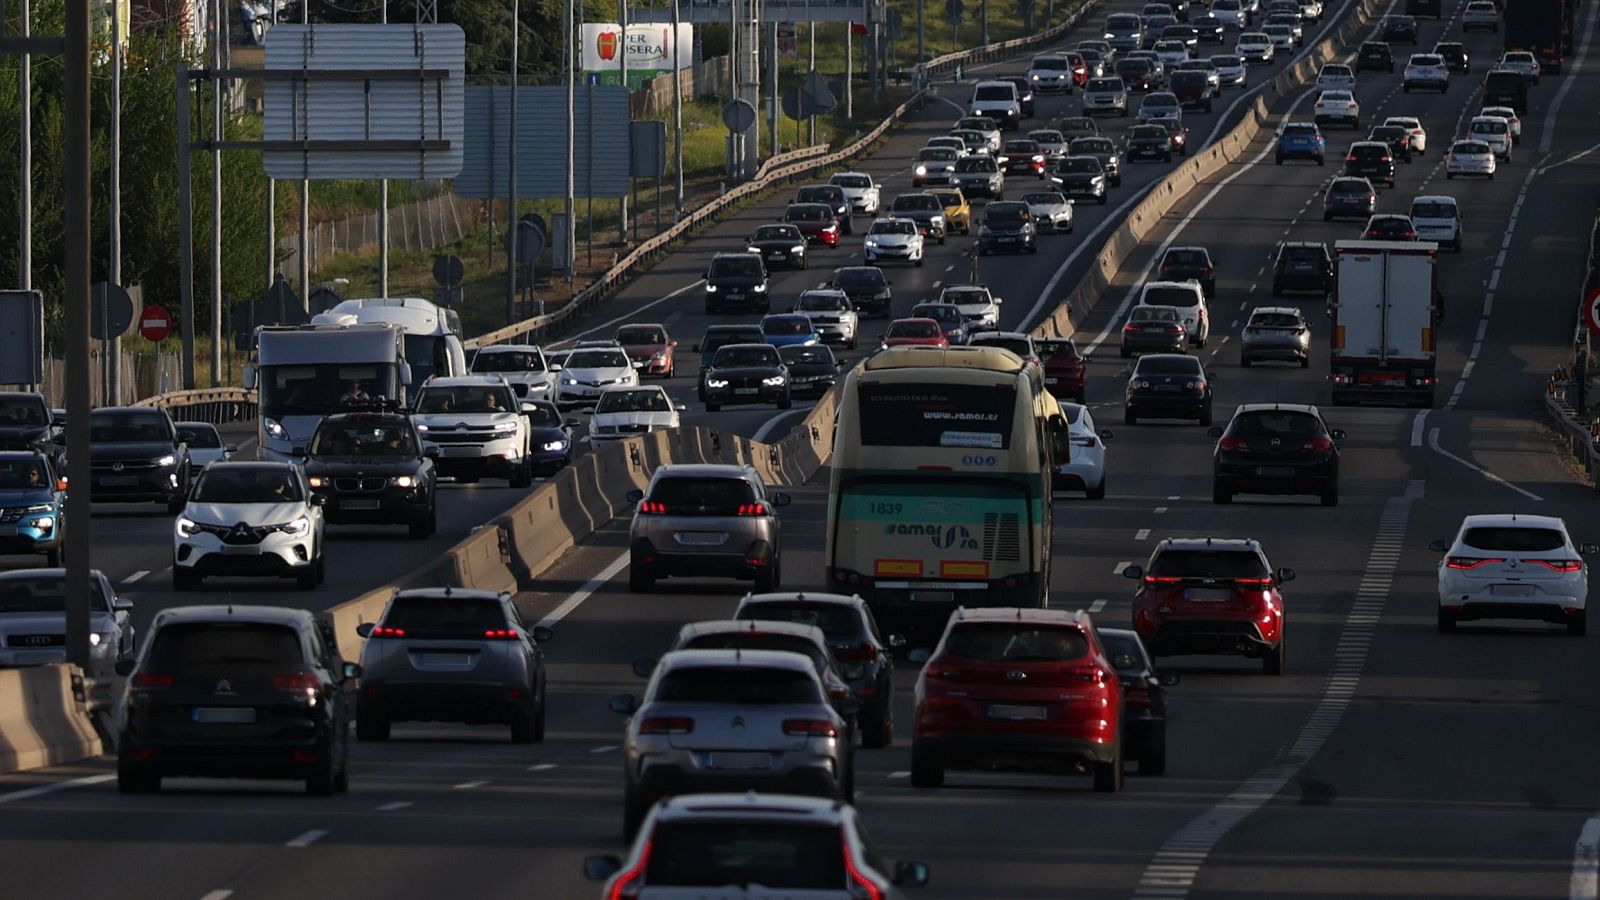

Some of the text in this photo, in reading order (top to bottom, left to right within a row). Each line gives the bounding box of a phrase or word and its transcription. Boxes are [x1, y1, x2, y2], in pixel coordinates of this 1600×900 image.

[923, 411, 998, 421] www.samar.es
[870, 502, 903, 515] 1839
[885, 524, 943, 536] samar
